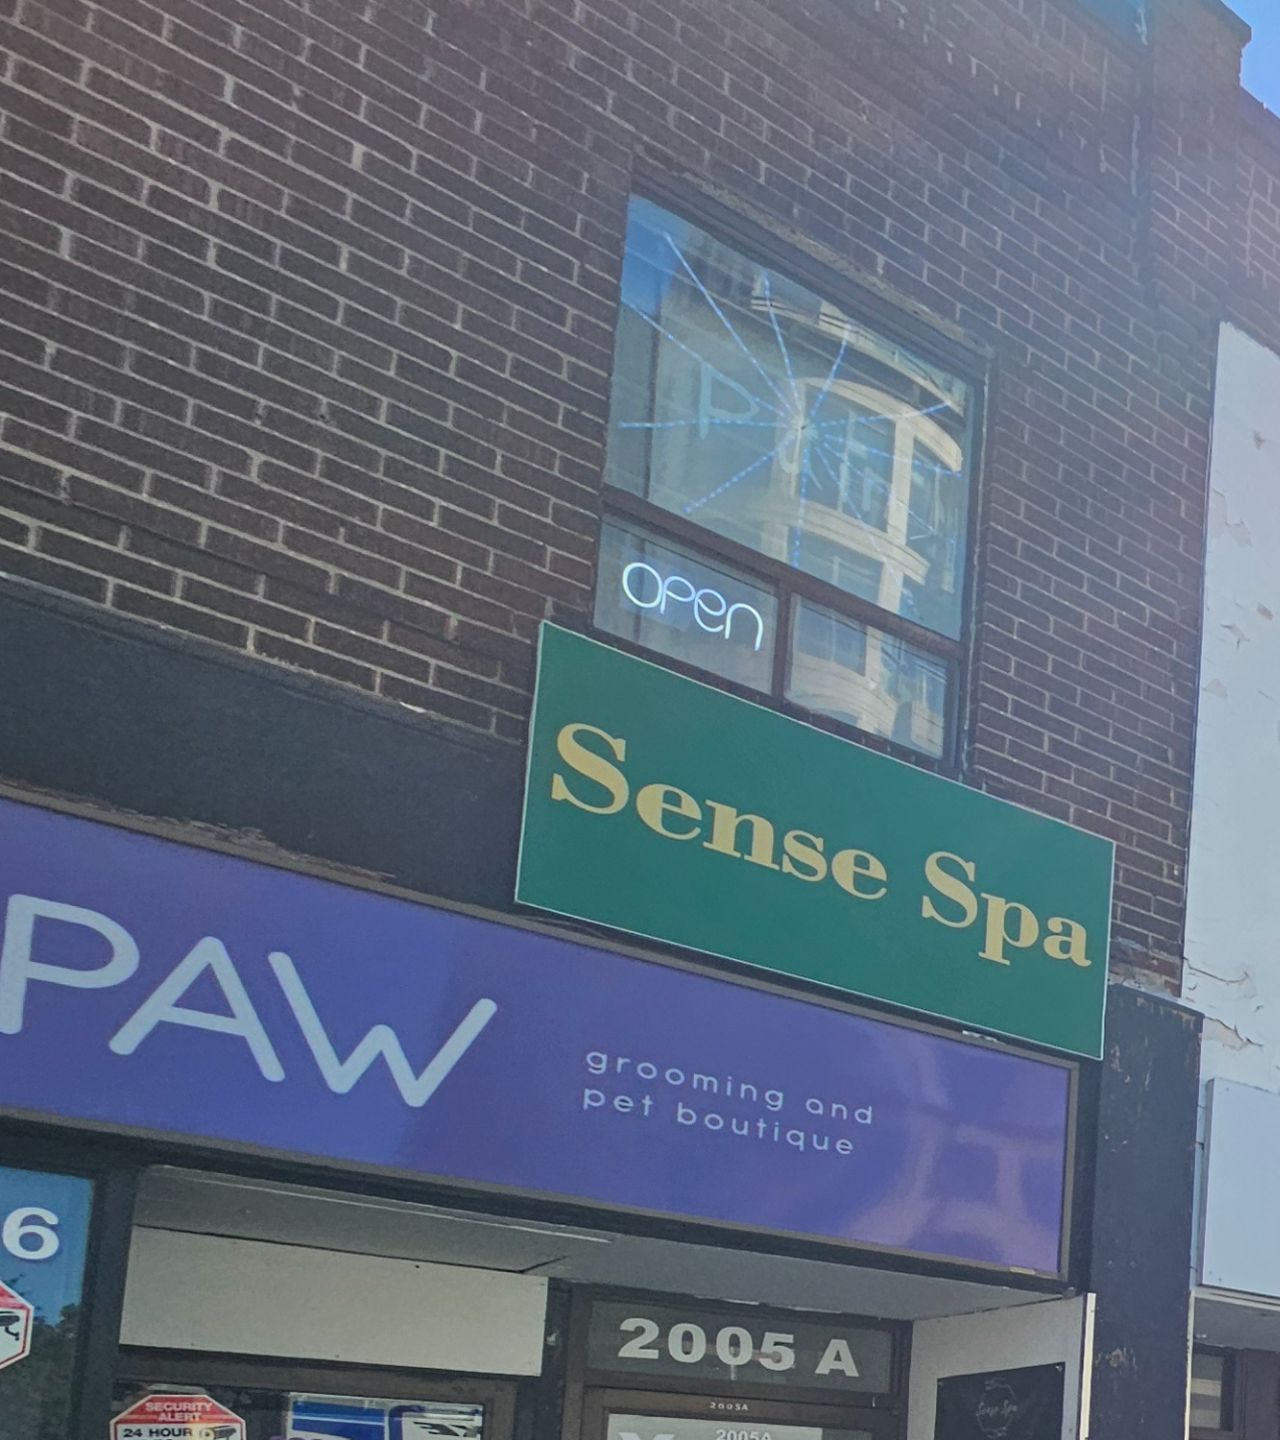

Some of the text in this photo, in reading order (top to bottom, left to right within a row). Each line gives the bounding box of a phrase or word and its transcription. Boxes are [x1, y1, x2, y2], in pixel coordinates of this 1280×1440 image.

[551, 722, 1092, 965] Sense Spa
[0, 893, 498, 1108] PAW
[586, 1051, 873, 1125] grooming and
[583, 1088, 853, 1154] pet boutique
[3, 1207, 60, 1260] 6
[618, 1318, 860, 1378] 2005 A
[124, 1428, 193, 1437] 24 HOUR
[145, 1402, 213, 1411] SECURITY
[159, 1413, 202, 1421] ALERT
